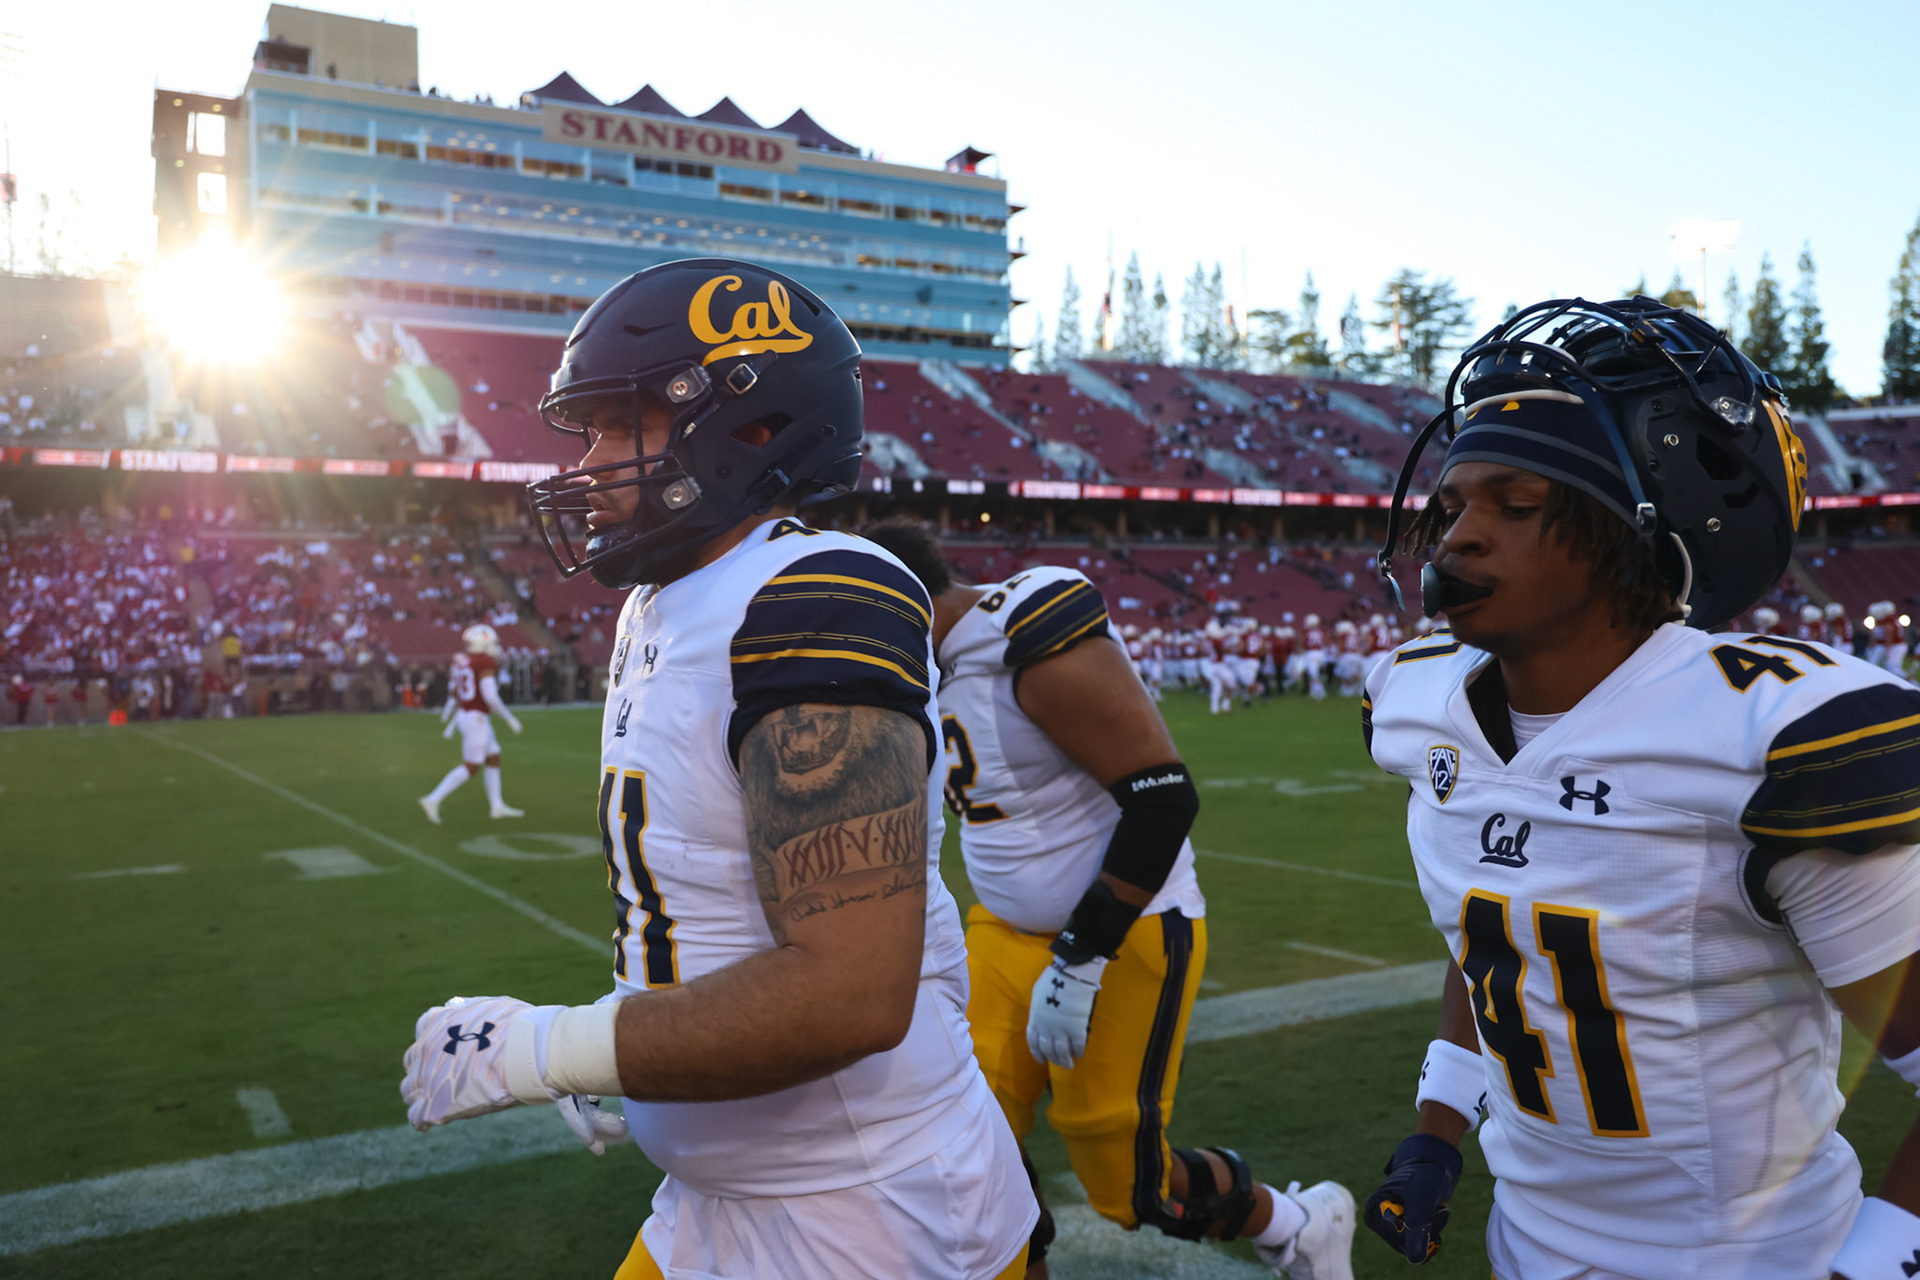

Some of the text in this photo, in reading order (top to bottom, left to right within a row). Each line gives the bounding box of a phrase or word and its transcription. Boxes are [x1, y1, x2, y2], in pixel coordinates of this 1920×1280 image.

[561, 110, 784, 165] STANFORD
[688, 274, 814, 367] Cal
[1707, 634, 1841, 694] 41
[1137, 773, 1185, 790] Mueller
[1430, 747, 1456, 779] PAC
[1435, 770, 1449, 790] 12
[1479, 812, 1531, 869] Cal
[1459, 887, 1651, 1138] 41
